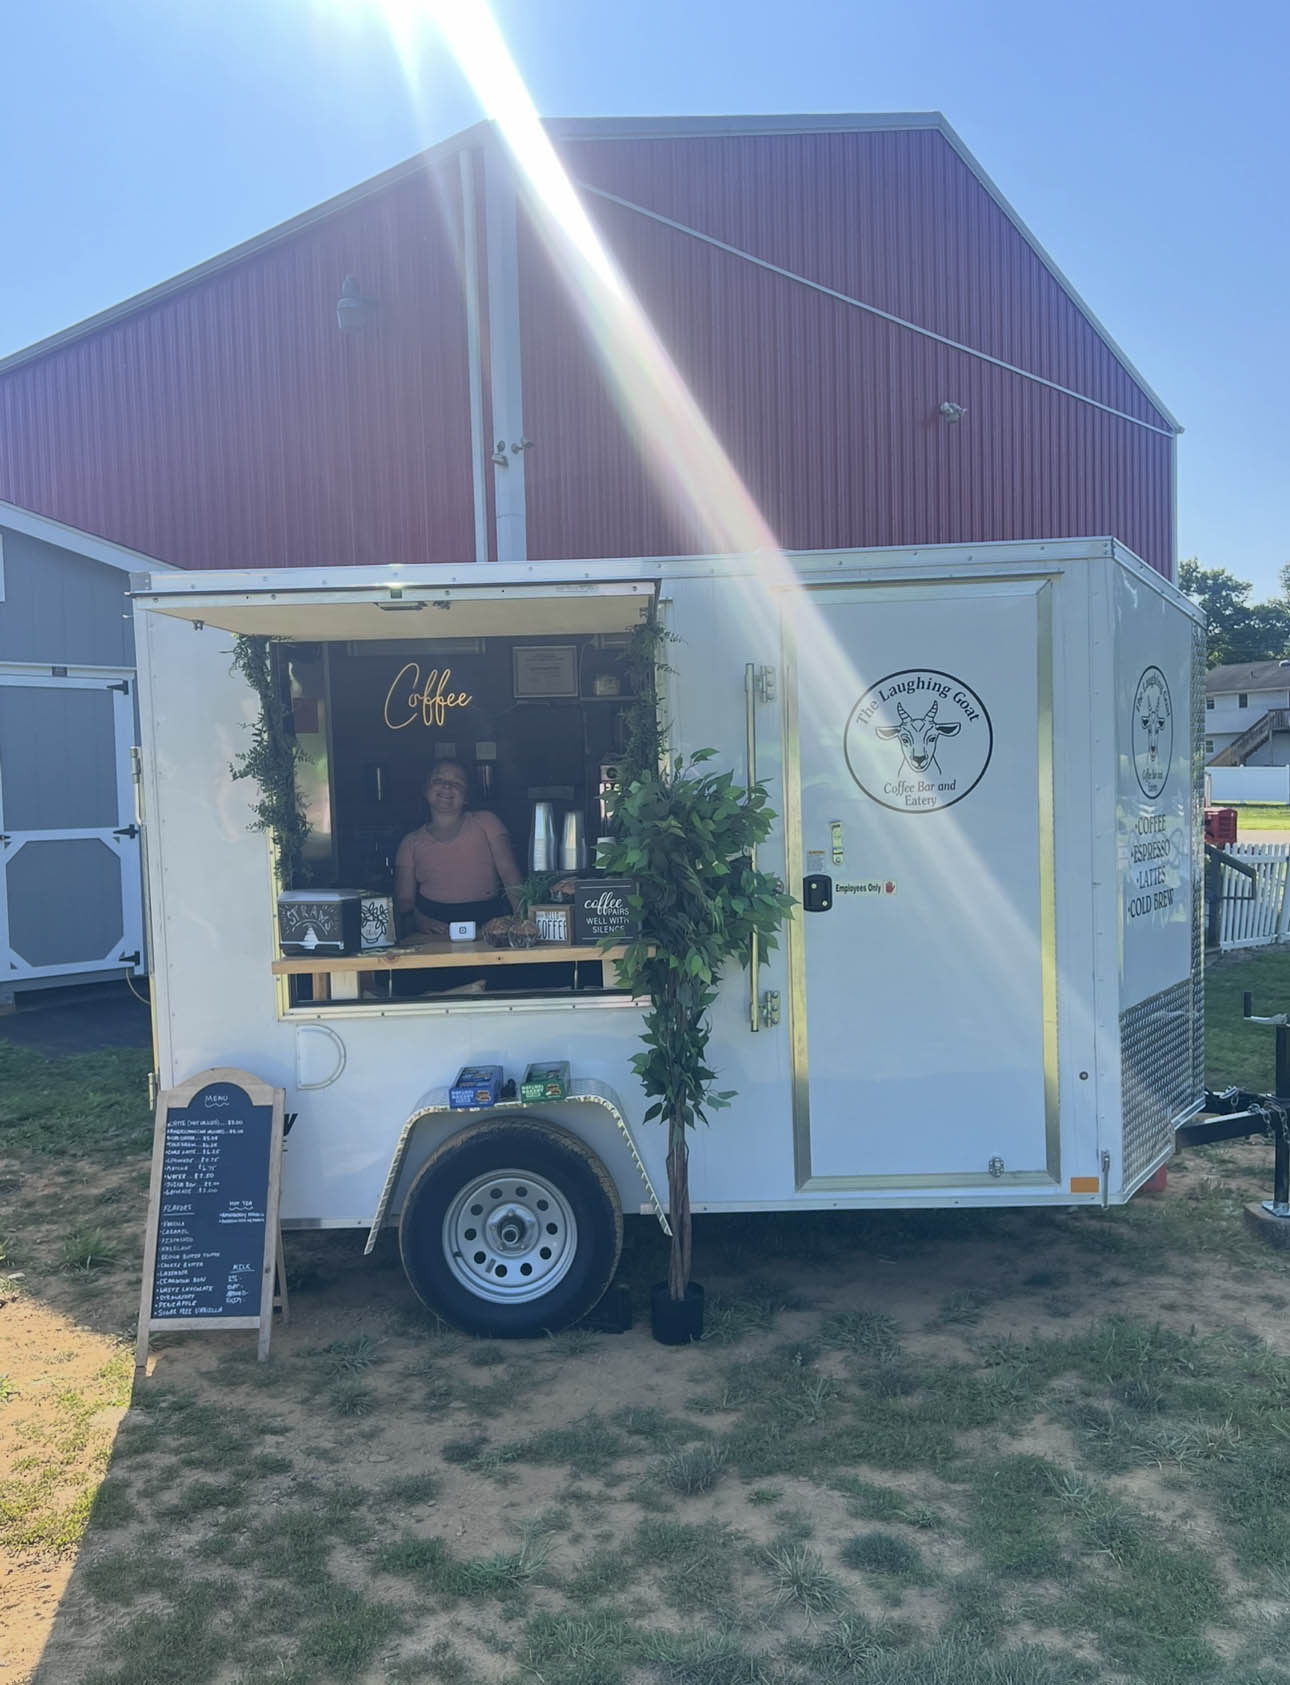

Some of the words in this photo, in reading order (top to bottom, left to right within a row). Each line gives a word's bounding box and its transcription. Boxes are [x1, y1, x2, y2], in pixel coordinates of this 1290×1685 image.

[384, 662, 473, 729] Coffee
[856, 699, 880, 725] The
[878, 677, 952, 702] Laughing
[952, 691, 980, 721] Goat
[883, 780, 916, 797] Coffee
[917, 781, 935, 792] Bar
[937, 779, 957, 791] and
[905, 794, 937, 808] Eatery
[836, 883, 866, 895] Employees
[868, 883, 881, 894] Only
[584, 891, 623, 915] coffee
[608, 907, 629, 916] PAIRS
[1130, 895, 1152, 918] COLD
[1153, 888, 1174, 911] BREW
[586, 917, 608, 926] WELL
